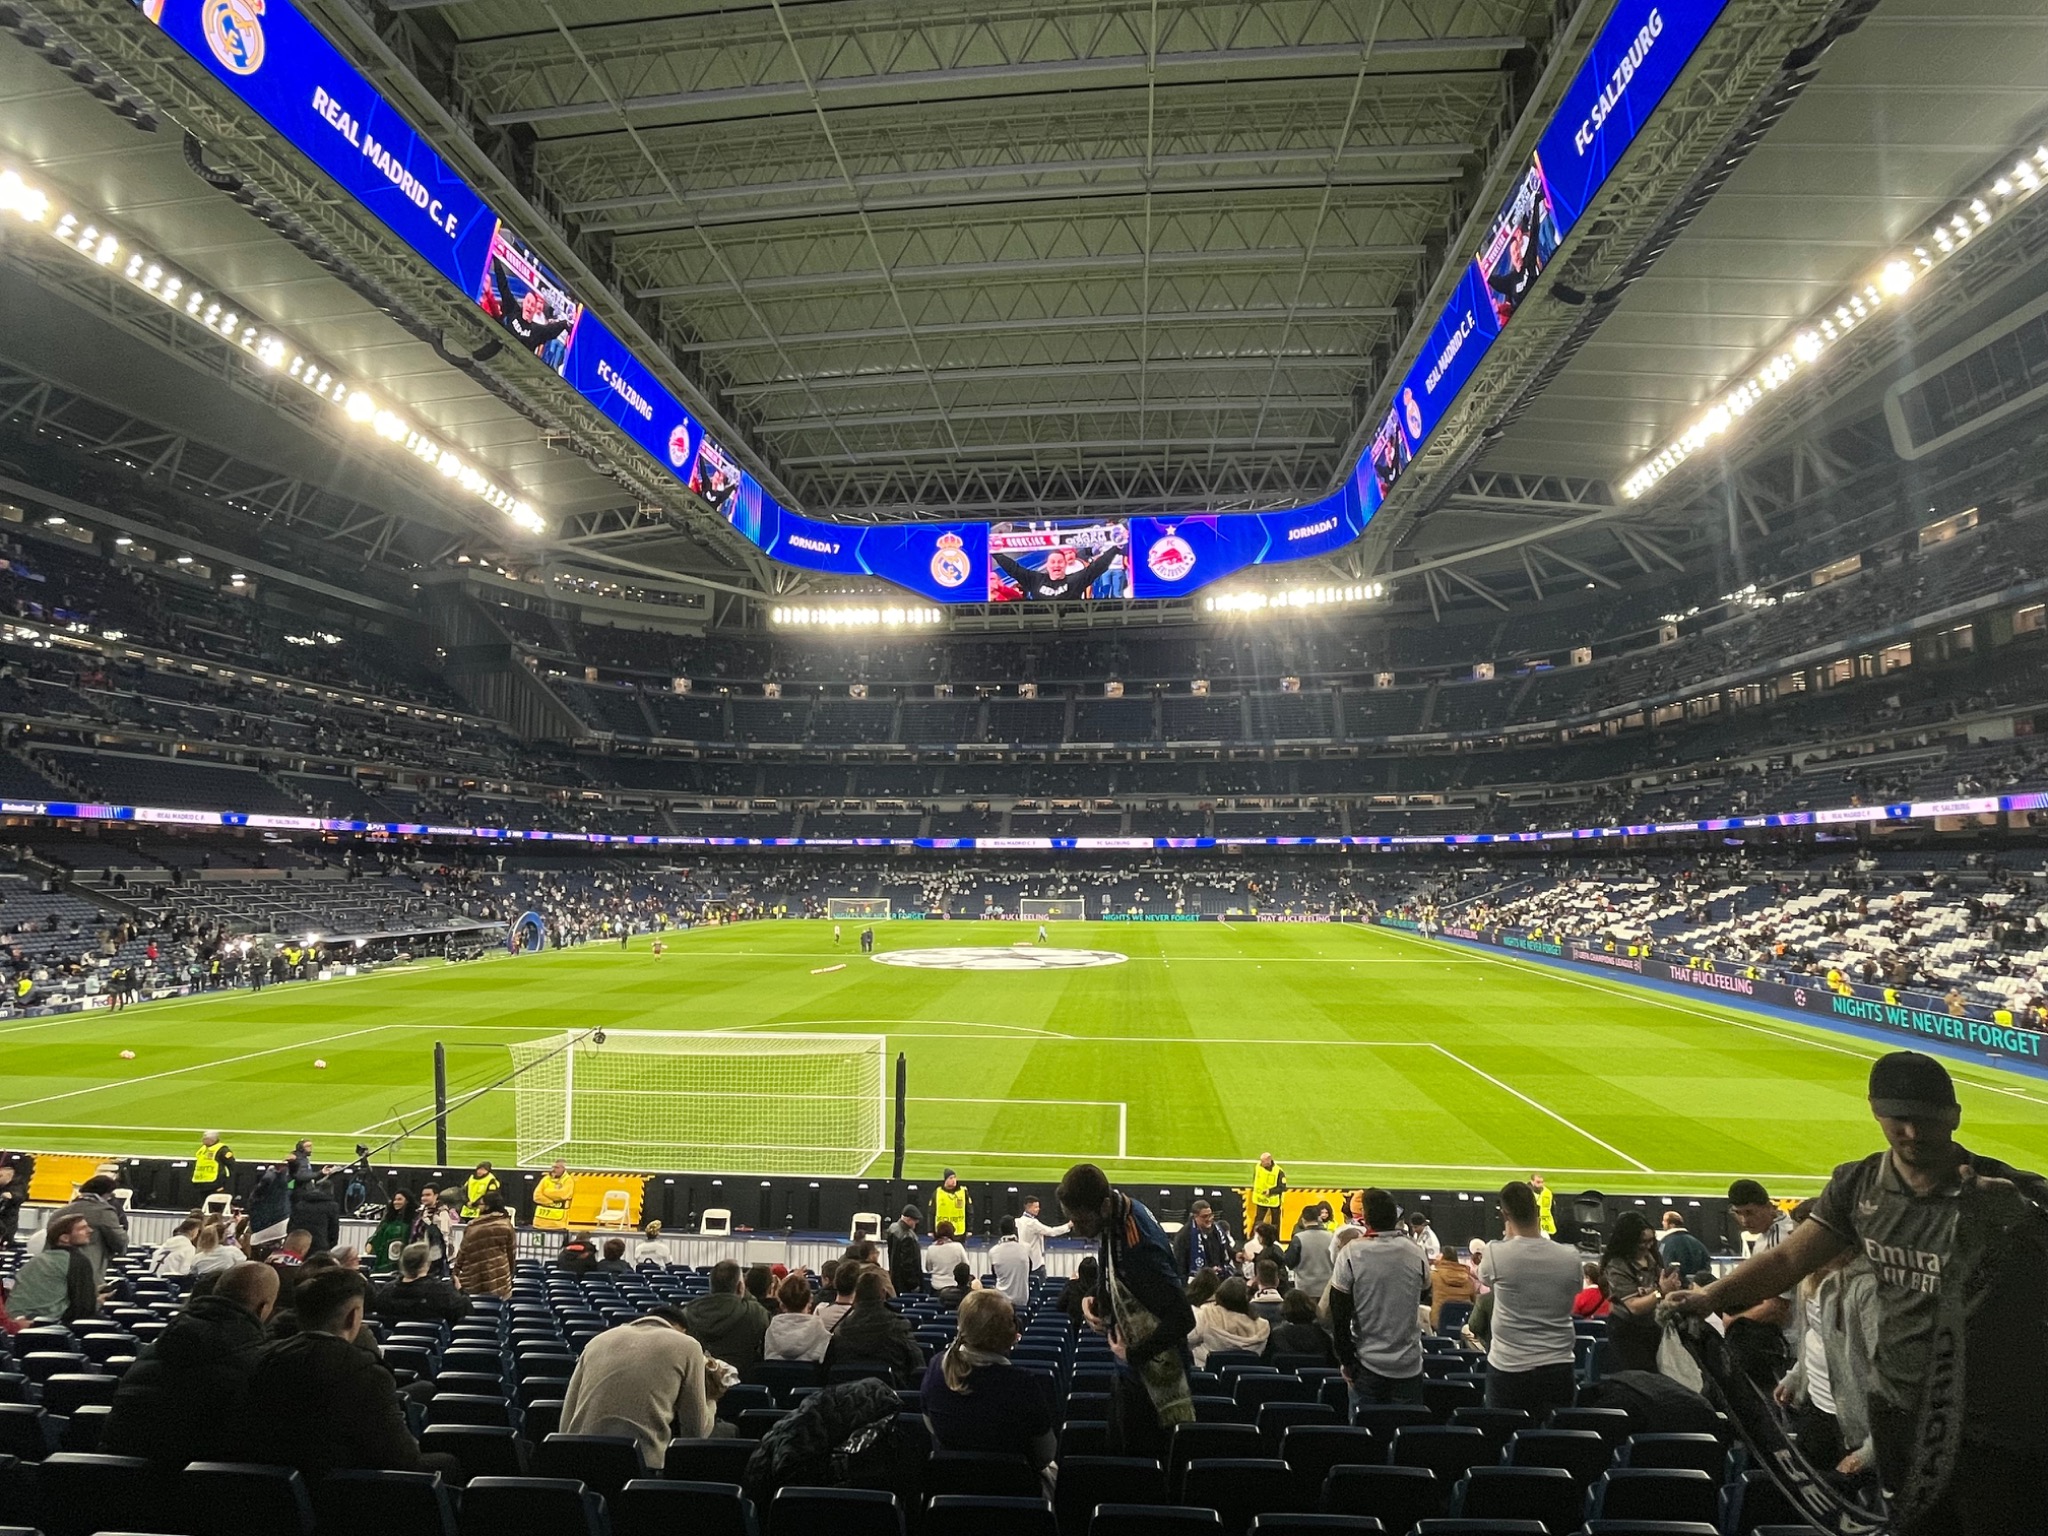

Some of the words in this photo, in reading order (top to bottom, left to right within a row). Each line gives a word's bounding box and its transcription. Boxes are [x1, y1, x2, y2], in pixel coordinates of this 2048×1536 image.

[1575, 119, 1594, 157] FC
[1591, 7, 1664, 131] SALZBURG
[312, 86, 360, 148] REAL
[362, 134, 429, 209] MADRID
[429, 199, 443, 227] C.
[445, 213, 458, 239] F.
[1425, 366, 1442, 395] REAL
[1438, 330, 1463, 375] MADRID
[597, 359, 611, 383] FC
[609, 372, 653, 421] SALZBURG
[789, 535, 832, 554] JORNADA
[833, 544, 840, 555] 7
[1288, 521, 1332, 541] JORNADA
[1331, 517, 1338, 528] 7
[1278, 915, 1331, 923] #UCLFEELING
[1579, 950, 1590, 960] UEFA
[1590, 952, 1615, 965] CHAMPIONS
[1615, 957, 1634, 969] LEAGUE
[1669, 965, 1691, 982] THAT
[1692, 969, 1753, 995] #UCLFEELING
[1832, 996, 1883, 1022] NIGHTS
[1885, 1006, 1909, 1028] WE
[1912, 1011, 1965, 1040] NEVER
[1968, 1022, 2041, 1056] FORGET
